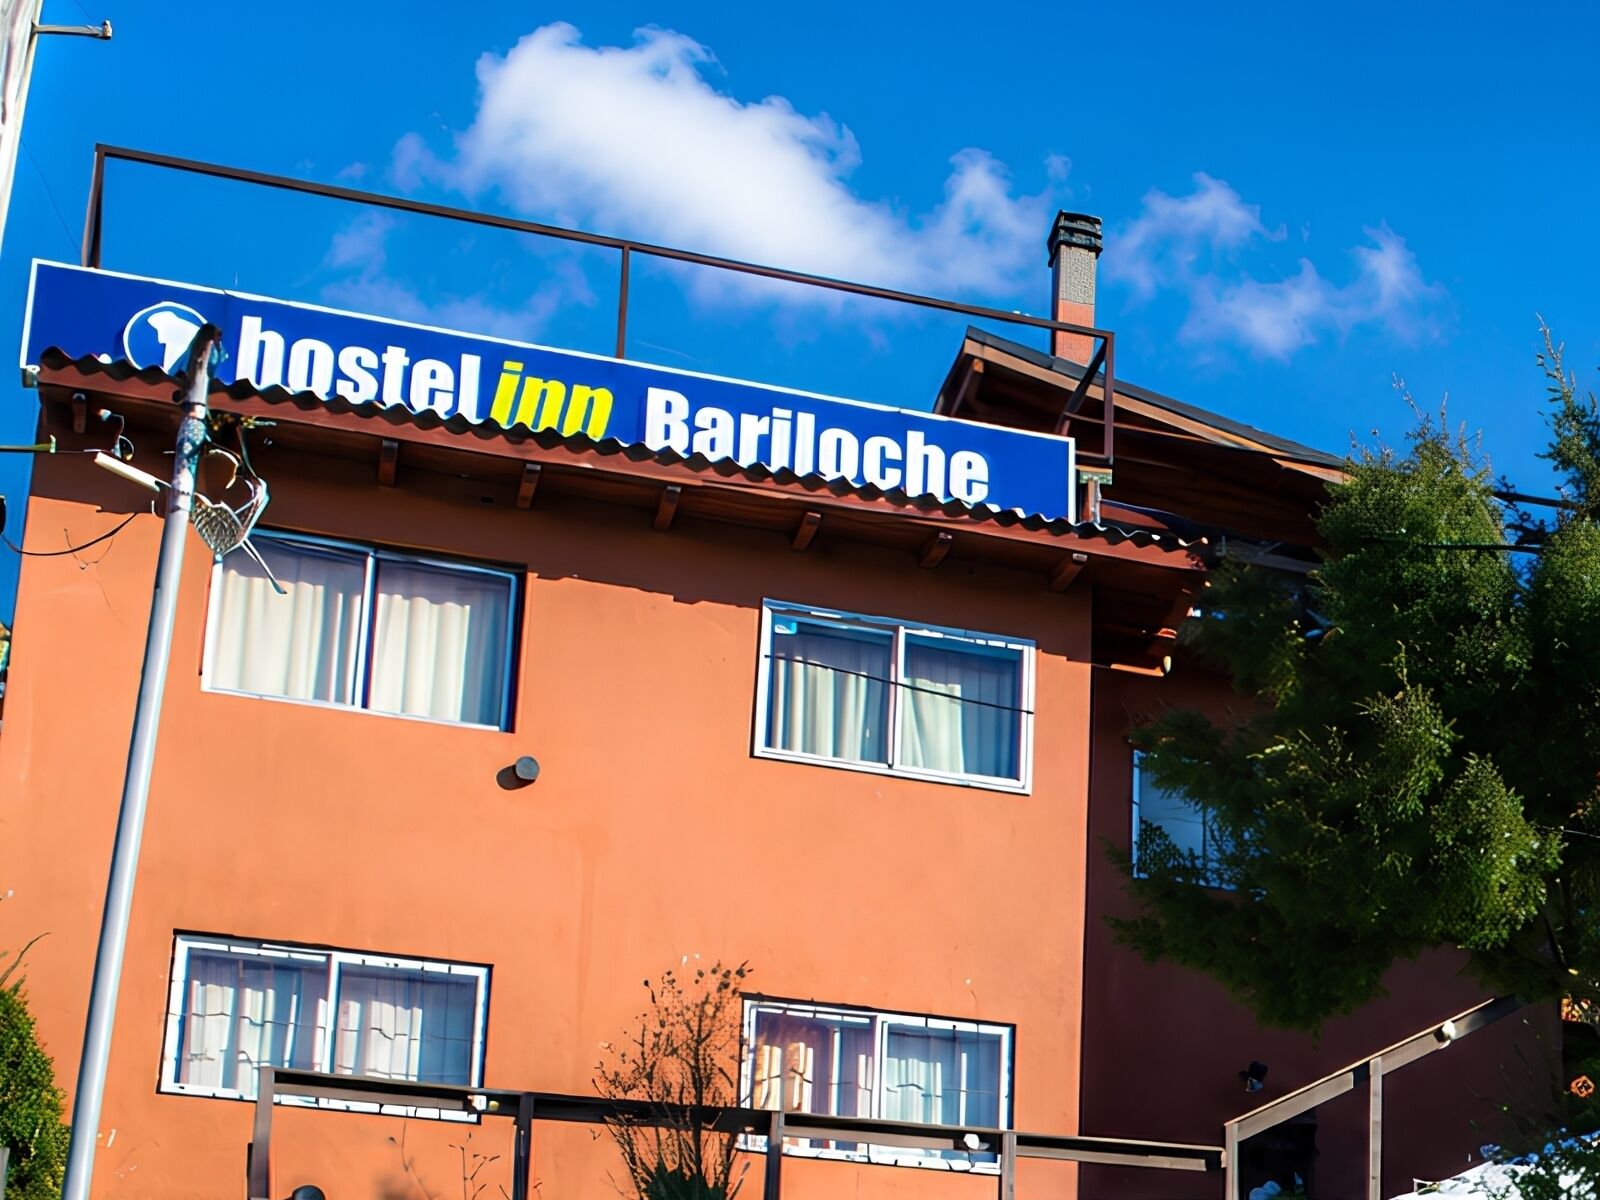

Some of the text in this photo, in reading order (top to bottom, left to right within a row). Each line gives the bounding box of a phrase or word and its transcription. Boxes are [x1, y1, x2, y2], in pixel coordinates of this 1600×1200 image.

[235, 315, 989, 503] hostel inn Bariloche
